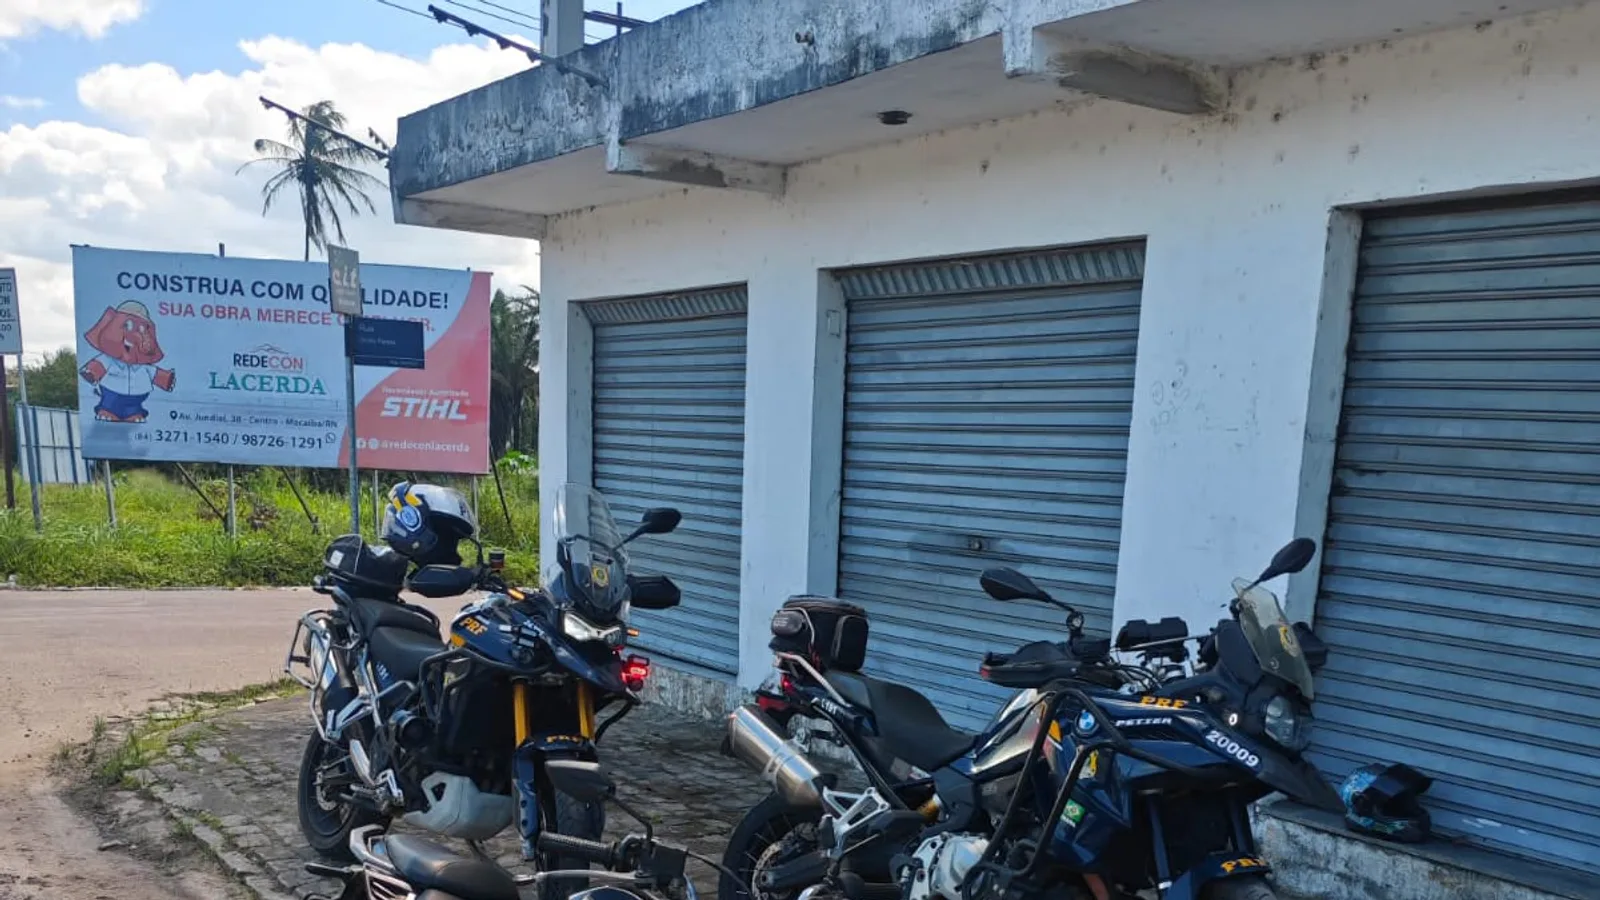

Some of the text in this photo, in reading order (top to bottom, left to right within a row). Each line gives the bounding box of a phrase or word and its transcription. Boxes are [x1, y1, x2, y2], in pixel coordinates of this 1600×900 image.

[116, 271, 449, 310] CONSTRUA COM QLIDADE!
[158, 301, 195, 318] SUA
[201, 303, 251, 321] OBRA
[257, 308, 332, 326] MERECE
[233, 352, 303, 370] REDECON
[208, 371, 328, 395] LACERDA
[380, 396, 468, 420] STIHL
[249, 415, 279, 425] Centro
[155, 430, 230, 444] 3271-1540
[241, 433, 323, 450] 98726-1291
[458, 616, 489, 636] PRF
[1139, 695, 1191, 710] PRF
[1205, 729, 1261, 768] 20009
